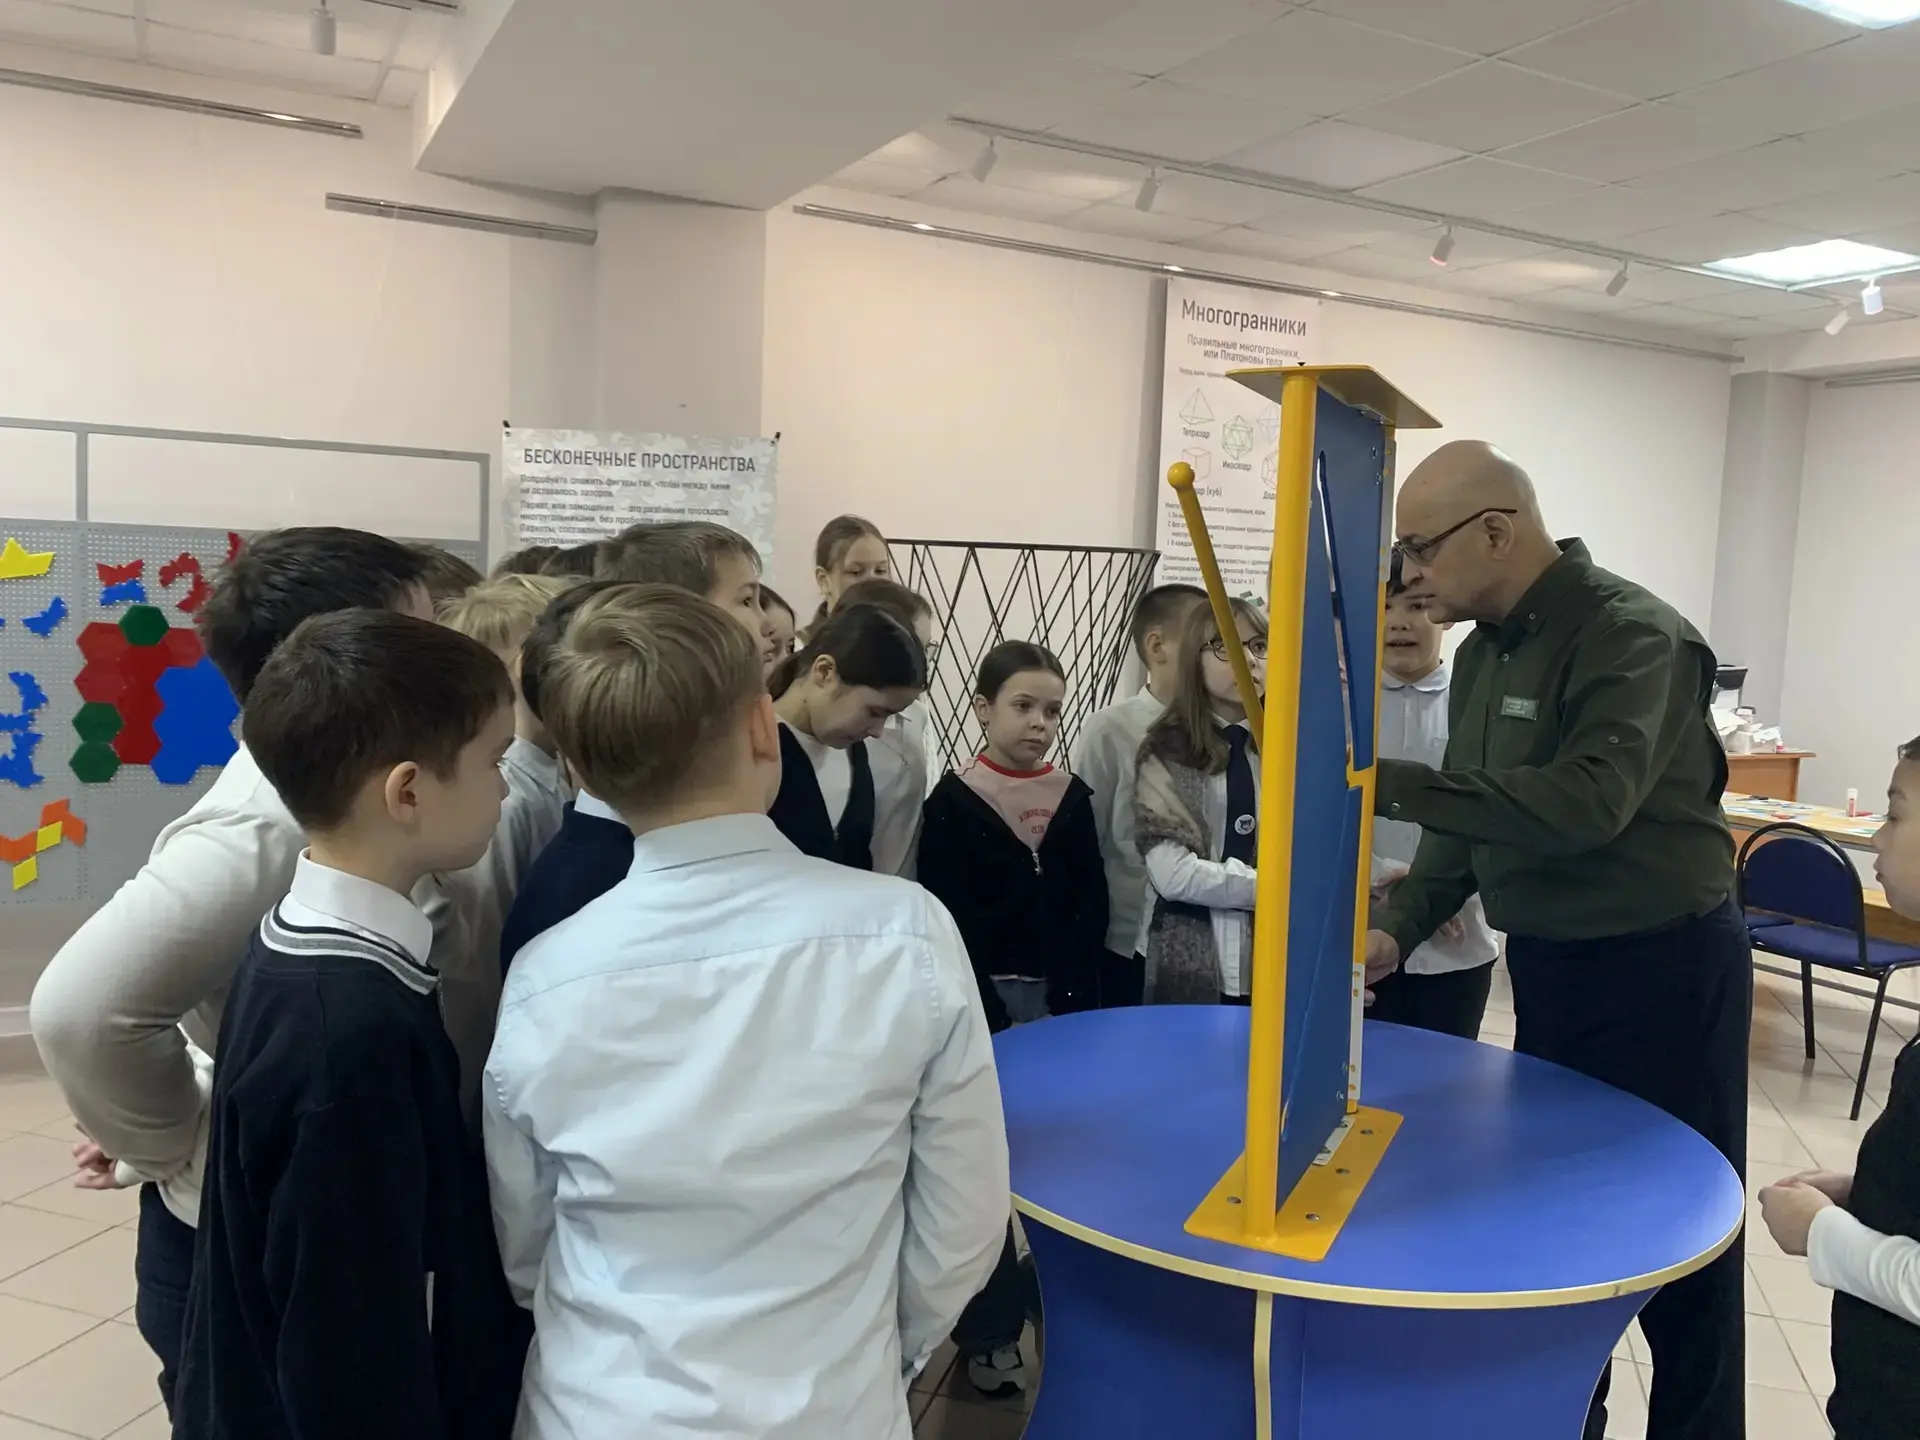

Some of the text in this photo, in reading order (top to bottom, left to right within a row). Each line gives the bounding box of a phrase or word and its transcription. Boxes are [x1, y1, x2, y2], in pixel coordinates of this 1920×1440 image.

[1182, 298, 1307, 336] Многогранники
[1187, 333, 1300, 359] Правильные многогранники,
[1203, 348, 1283, 367] или Платоновы тела
[1182, 427, 1210, 439] Тетраэдр
[524, 448, 756, 472] БЕСКОНЕЧНЫЕ ПРОСТРАНСТВА
[1222, 460, 1252, 471] Икосаэдр
